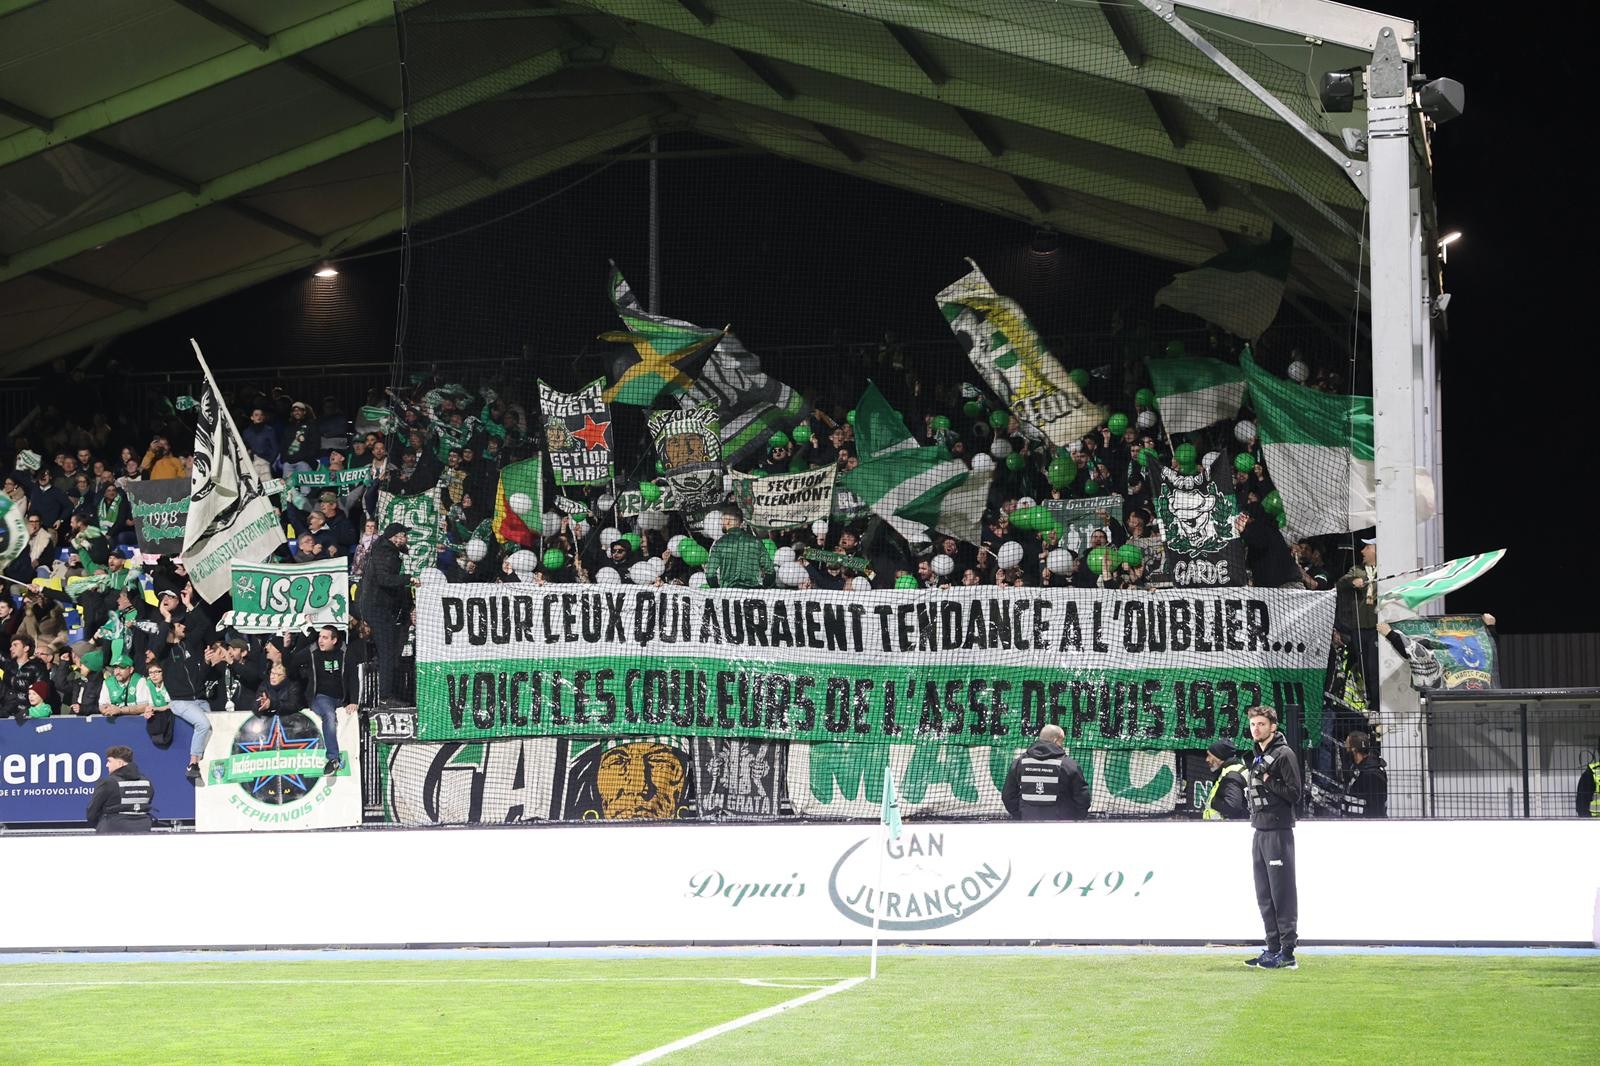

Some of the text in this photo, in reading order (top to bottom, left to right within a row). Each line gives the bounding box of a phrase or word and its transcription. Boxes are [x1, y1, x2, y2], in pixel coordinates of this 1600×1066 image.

[549, 448, 608, 467] ECTION
[298, 473, 326, 485] ALLEZ
[768, 471, 827, 492] SECTION
[756, 486, 832, 507] CLERMONT
[149, 510, 178, 526] 1998
[1173, 559, 1231, 585] GARDE
[442, 591, 1306, 653] POUR CEUX QUI AURAIENT TENDANCE A L'OUBLIER...
[447, 671, 541, 729] VOICI
[553, 669, 616, 726] LES
[625, 668, 816, 732] COULEURS
[825, 678, 874, 733] DE
[884, 678, 1012, 737] L'ASSE
[1021, 679, 1165, 739] DEPUIS
[375, 712, 417, 739] LE
[0, 752, 101, 784] erno
[231, 751, 326, 775] Indépendantistes
[24, 786, 95, 796] PHOTOVOLTAÏQU
[886, 833, 944, 859] GAN
[687, 868, 806, 907] Depuis
[846, 862, 1002, 918] JURANÇON
[1027, 870, 1125, 897] 1949
